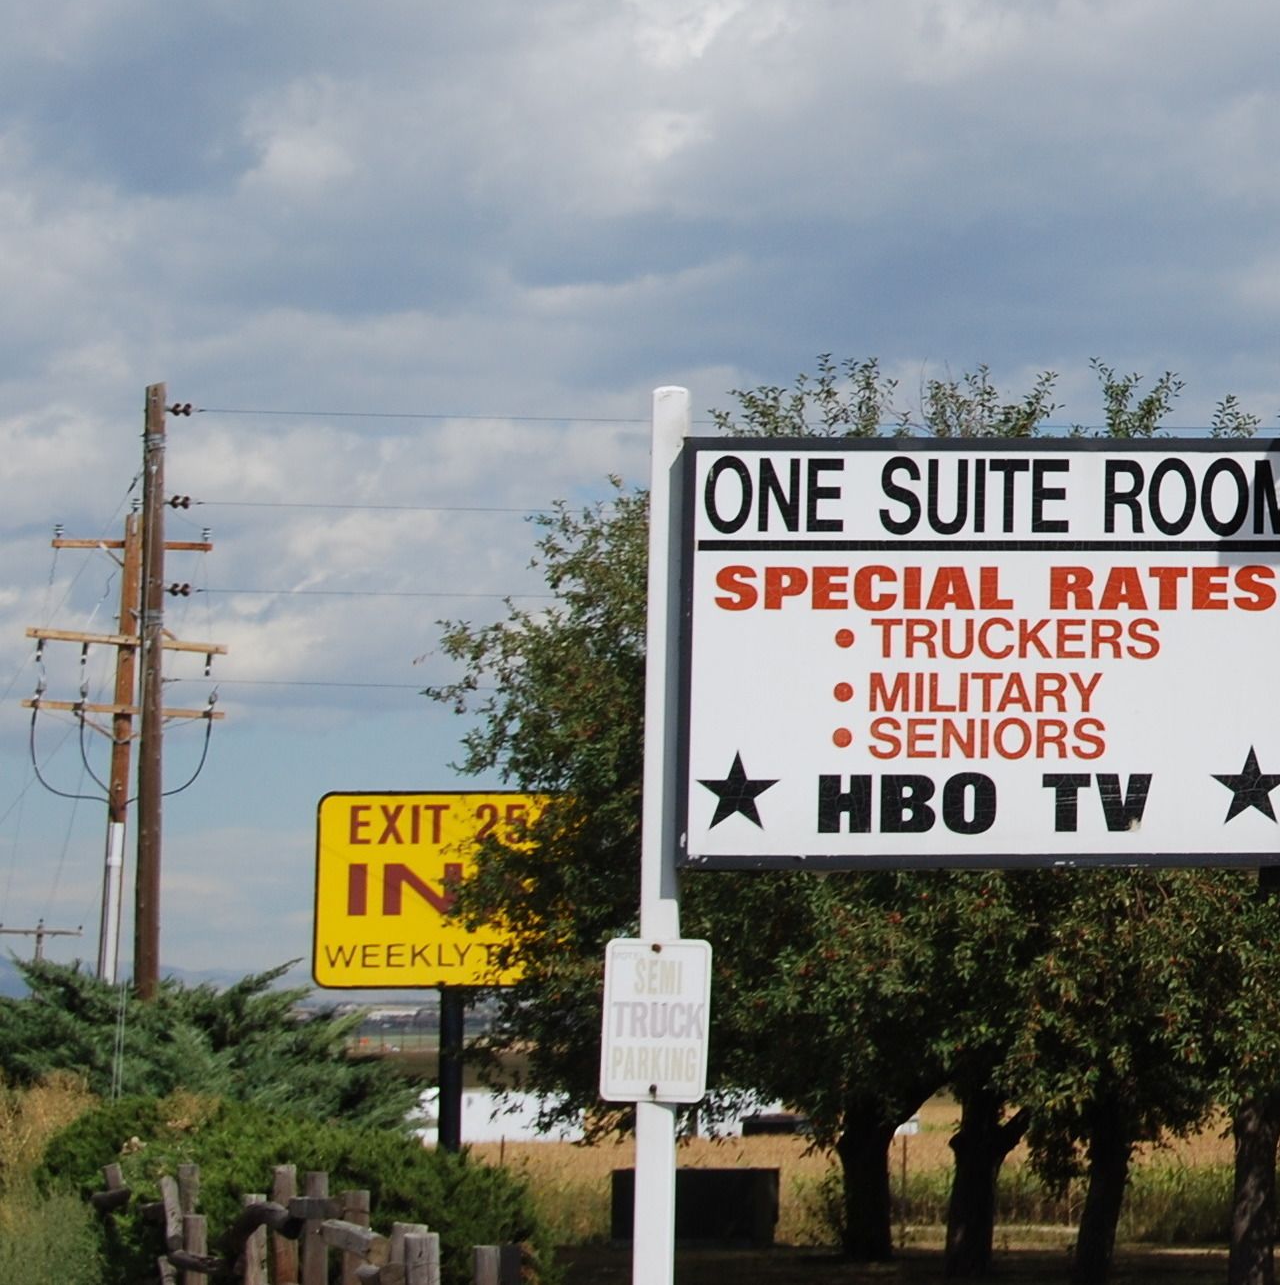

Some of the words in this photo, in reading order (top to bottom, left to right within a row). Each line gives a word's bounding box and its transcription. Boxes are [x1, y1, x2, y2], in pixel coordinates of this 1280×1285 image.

[703, 455, 846, 534] ONE
[879, 457, 1070, 537] SUITE
[713, 564, 1014, 612] SPECIAL
[1049, 564, 1278, 612] RATES
[870, 617, 1161, 660] TRUCKERS
[868, 672, 1103, 714] MILITARY
[868, 717, 1107, 761] SENIORS
[349, 804, 451, 845] EXIT
[475, 803, 551, 845] 25
[817, 773, 997, 835] HBO
[1042, 773, 1153, 833] TV
[325, 943, 472, 968] WEEKLY
[633, 958, 683, 995] SEMI
[612, 1001, 705, 1039] TRUCK
[611, 1044, 697, 1082] PARKING
